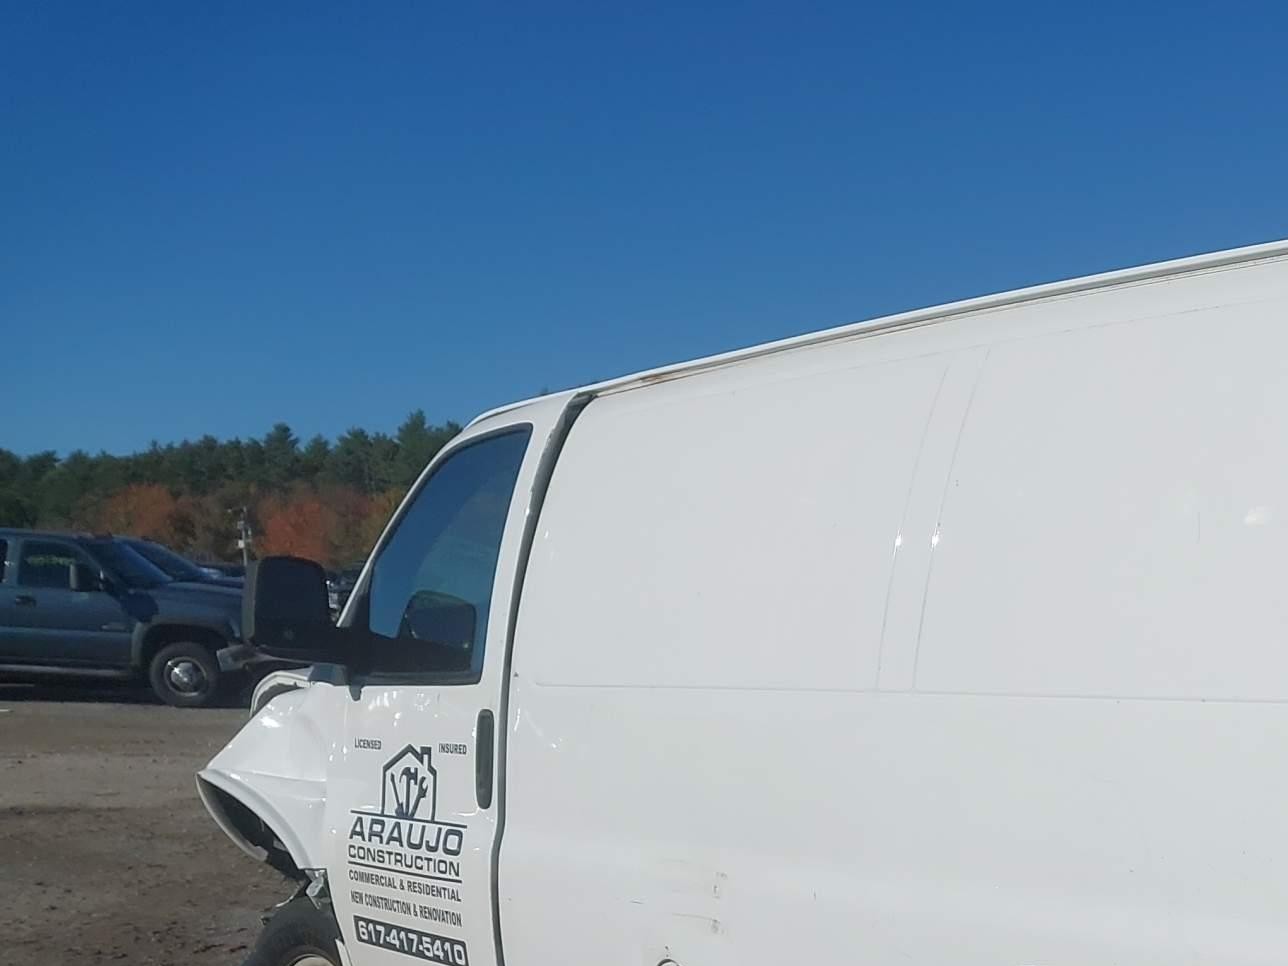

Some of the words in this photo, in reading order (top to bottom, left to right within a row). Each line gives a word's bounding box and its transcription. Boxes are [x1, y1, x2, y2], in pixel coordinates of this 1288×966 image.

[354, 737, 382, 750] LICENSED
[438, 743, 467, 755] INSURED
[349, 816, 464, 857] ARAUJO
[348, 844, 460, 877] CONSTRUCTION
[349, 869, 398, 890] COMMERCIAL
[399, 879, 405, 890] &
[407, 880, 462, 902] RESIDENTIAL
[350, 889, 364, 904] NEW
[364, 893, 412, 915] CONSTRUCTION
[413, 904, 419, 917] &
[419, 905, 462, 927] RENOVATION
[358, 920, 466, 966] 617-417-5410
